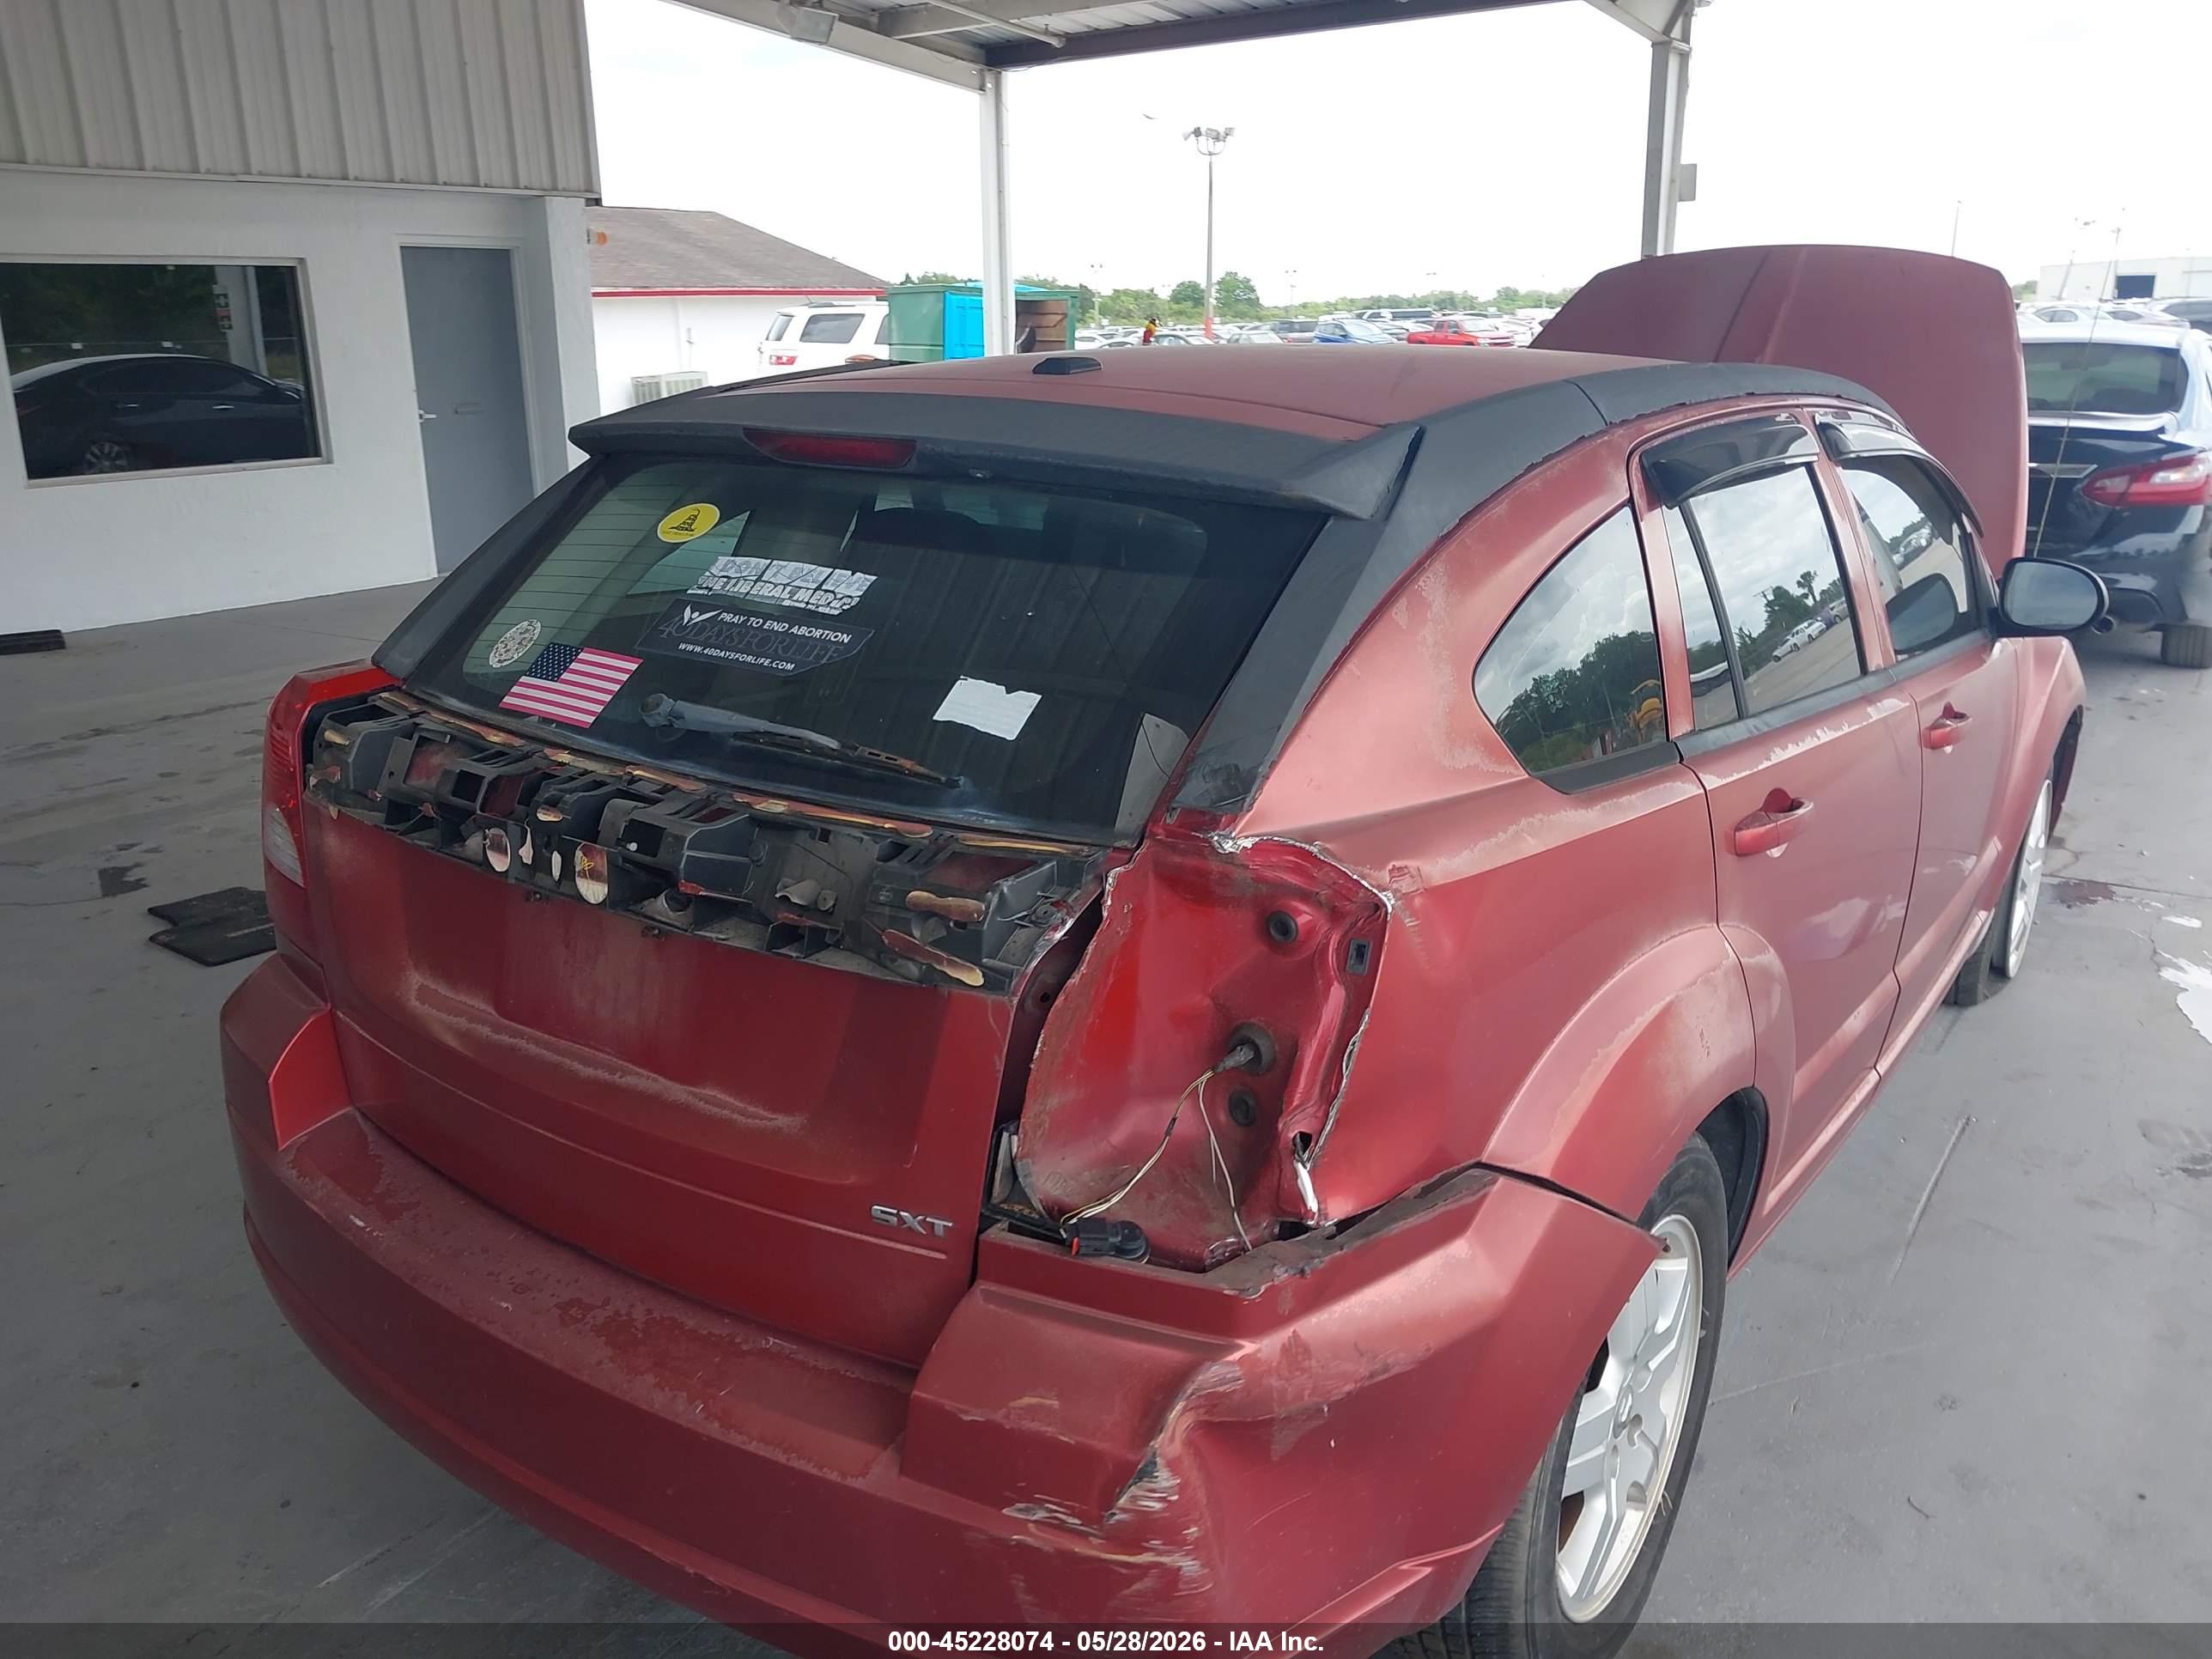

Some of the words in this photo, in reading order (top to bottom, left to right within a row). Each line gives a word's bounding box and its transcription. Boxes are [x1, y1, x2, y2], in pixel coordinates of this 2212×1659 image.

[698, 575, 723, 590] THE
[725, 578, 791, 599] LIBERAL
[717, 611, 746, 624] PRAY
[747, 617, 763, 629] TO
[763, 620, 789, 633] END
[788, 624, 853, 644] ABORTION
[678, 642, 796, 672] WWW.40DAYSFORLIFE.COM
[871, 1205, 953, 1237] SXT
